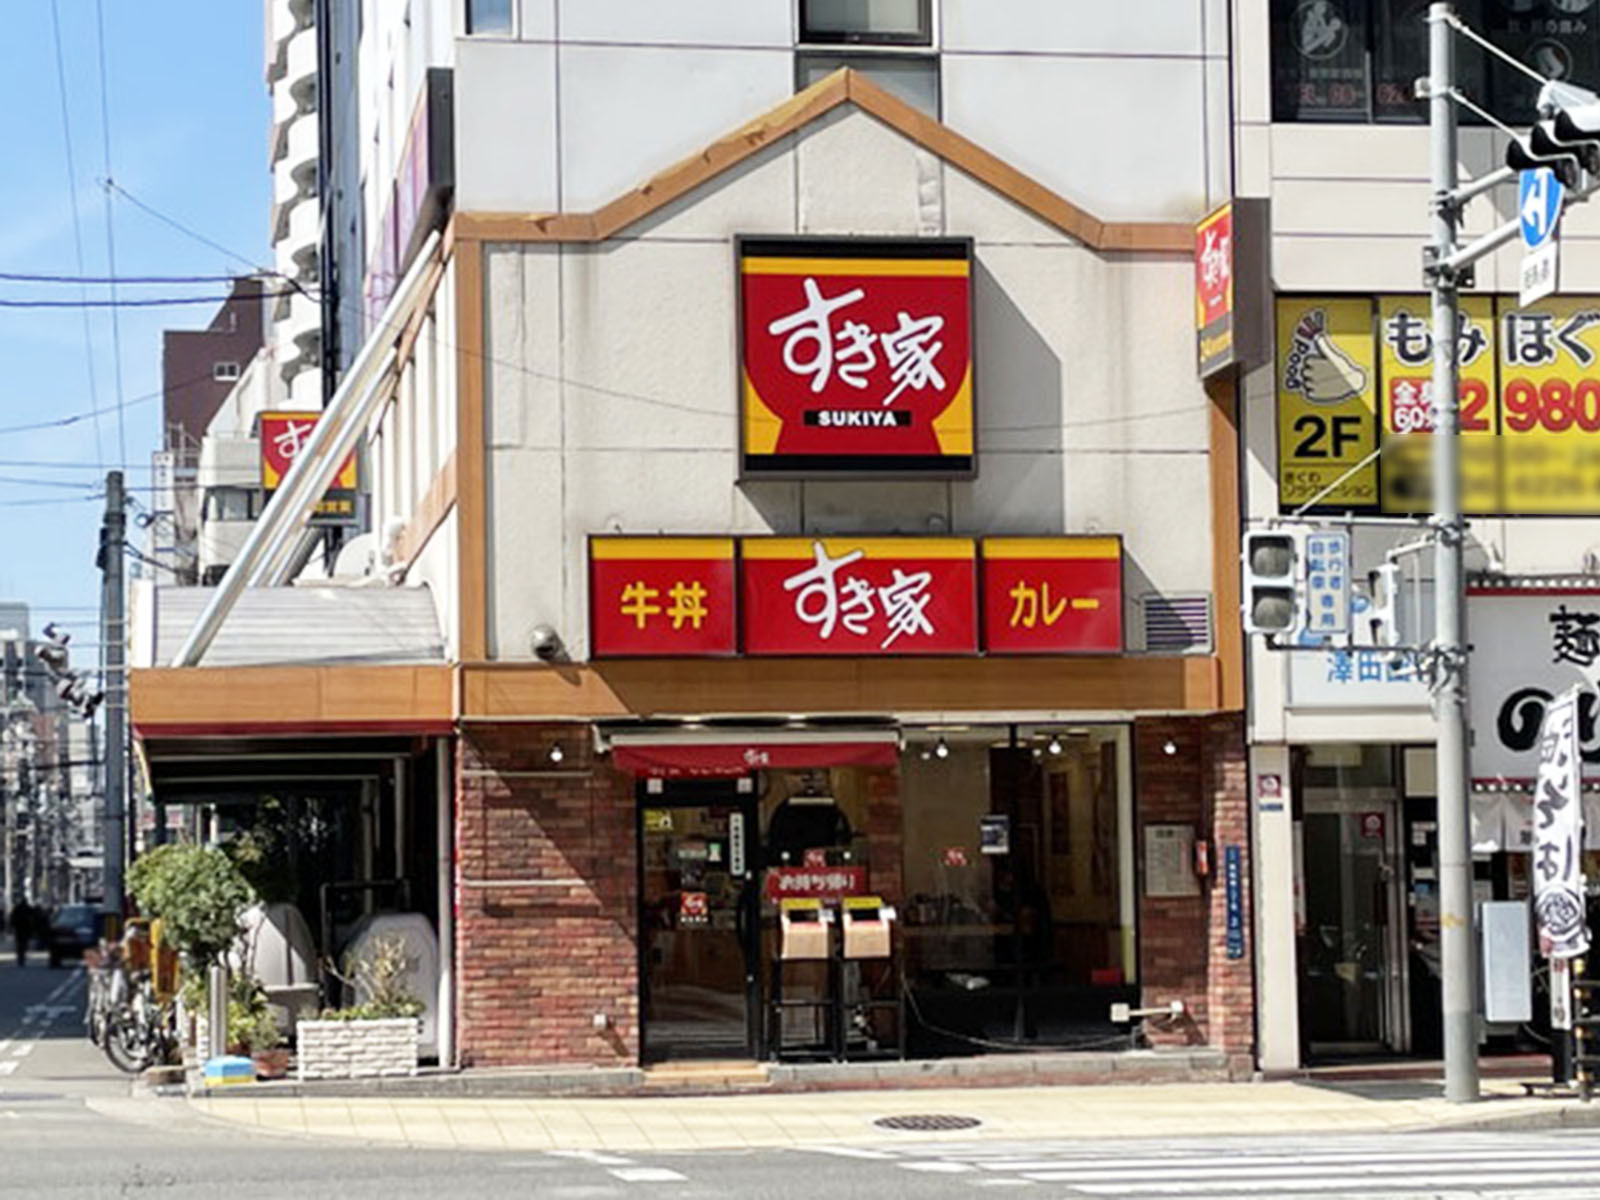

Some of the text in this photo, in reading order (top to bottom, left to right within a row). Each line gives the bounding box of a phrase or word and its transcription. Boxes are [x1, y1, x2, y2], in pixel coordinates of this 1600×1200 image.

[769, 277, 946, 406] すき家
[817, 410, 898, 427] SUKIYA
[1293, 415, 1361, 458] 2F
[620, 580, 708, 630] 牛丼
[784, 540, 935, 649] すき家
[1008, 580, 1101, 629] カレー
